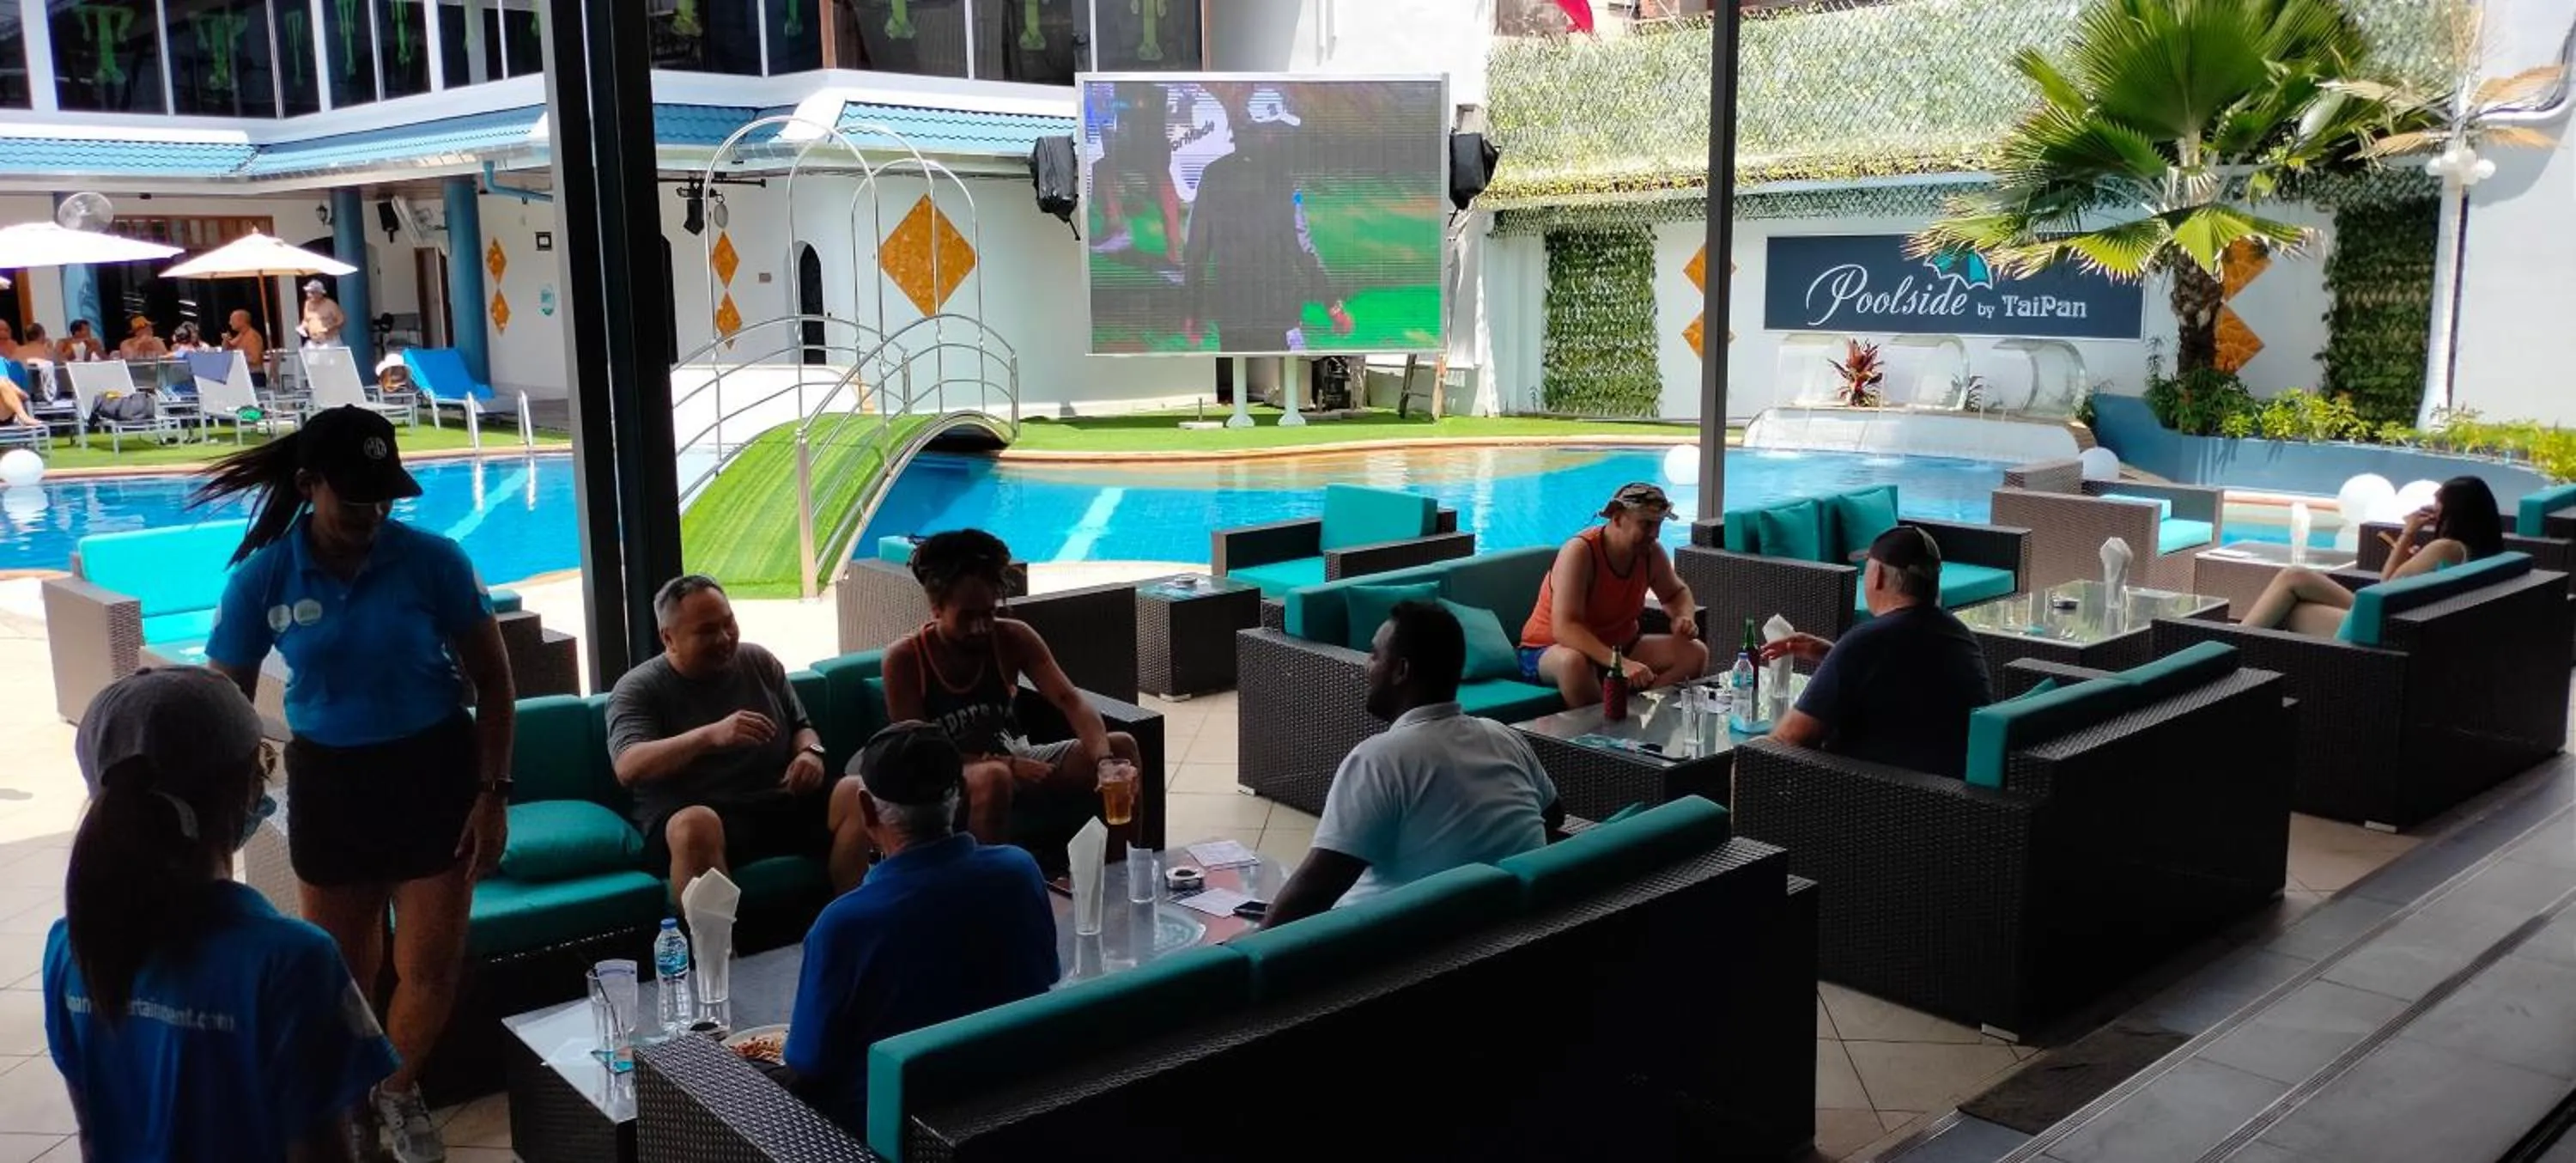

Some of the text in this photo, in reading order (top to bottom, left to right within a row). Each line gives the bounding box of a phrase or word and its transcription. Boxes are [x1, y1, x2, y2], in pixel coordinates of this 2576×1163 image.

[1806, 263, 2087, 326] Poolside by TaiPan
